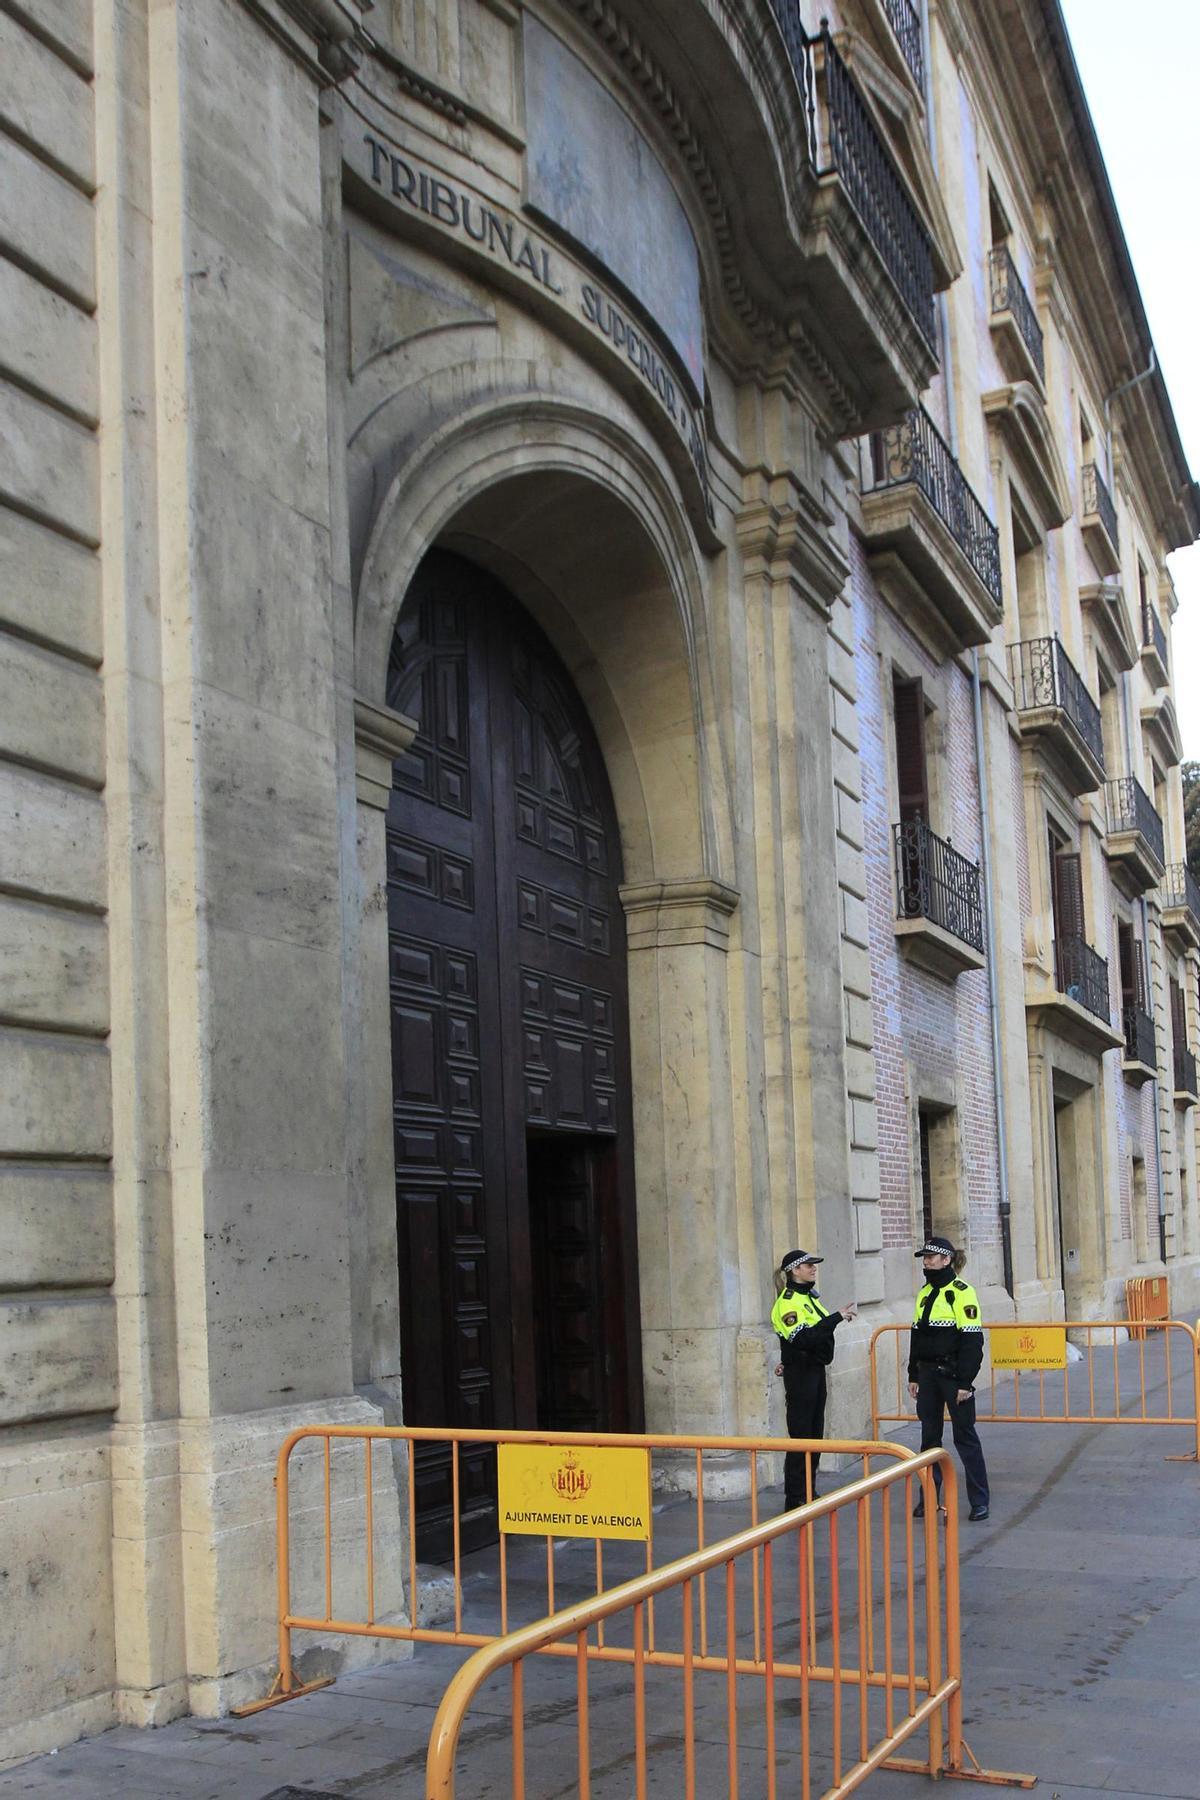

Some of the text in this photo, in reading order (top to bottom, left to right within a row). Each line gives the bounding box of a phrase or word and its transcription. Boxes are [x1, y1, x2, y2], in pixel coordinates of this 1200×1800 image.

[363, 133, 562, 295] TRIBUNAL
[580, 284, 678, 421] SUPERIOR
[505, 1511, 643, 1528] AJUNTAMENT DE VALENCIA
